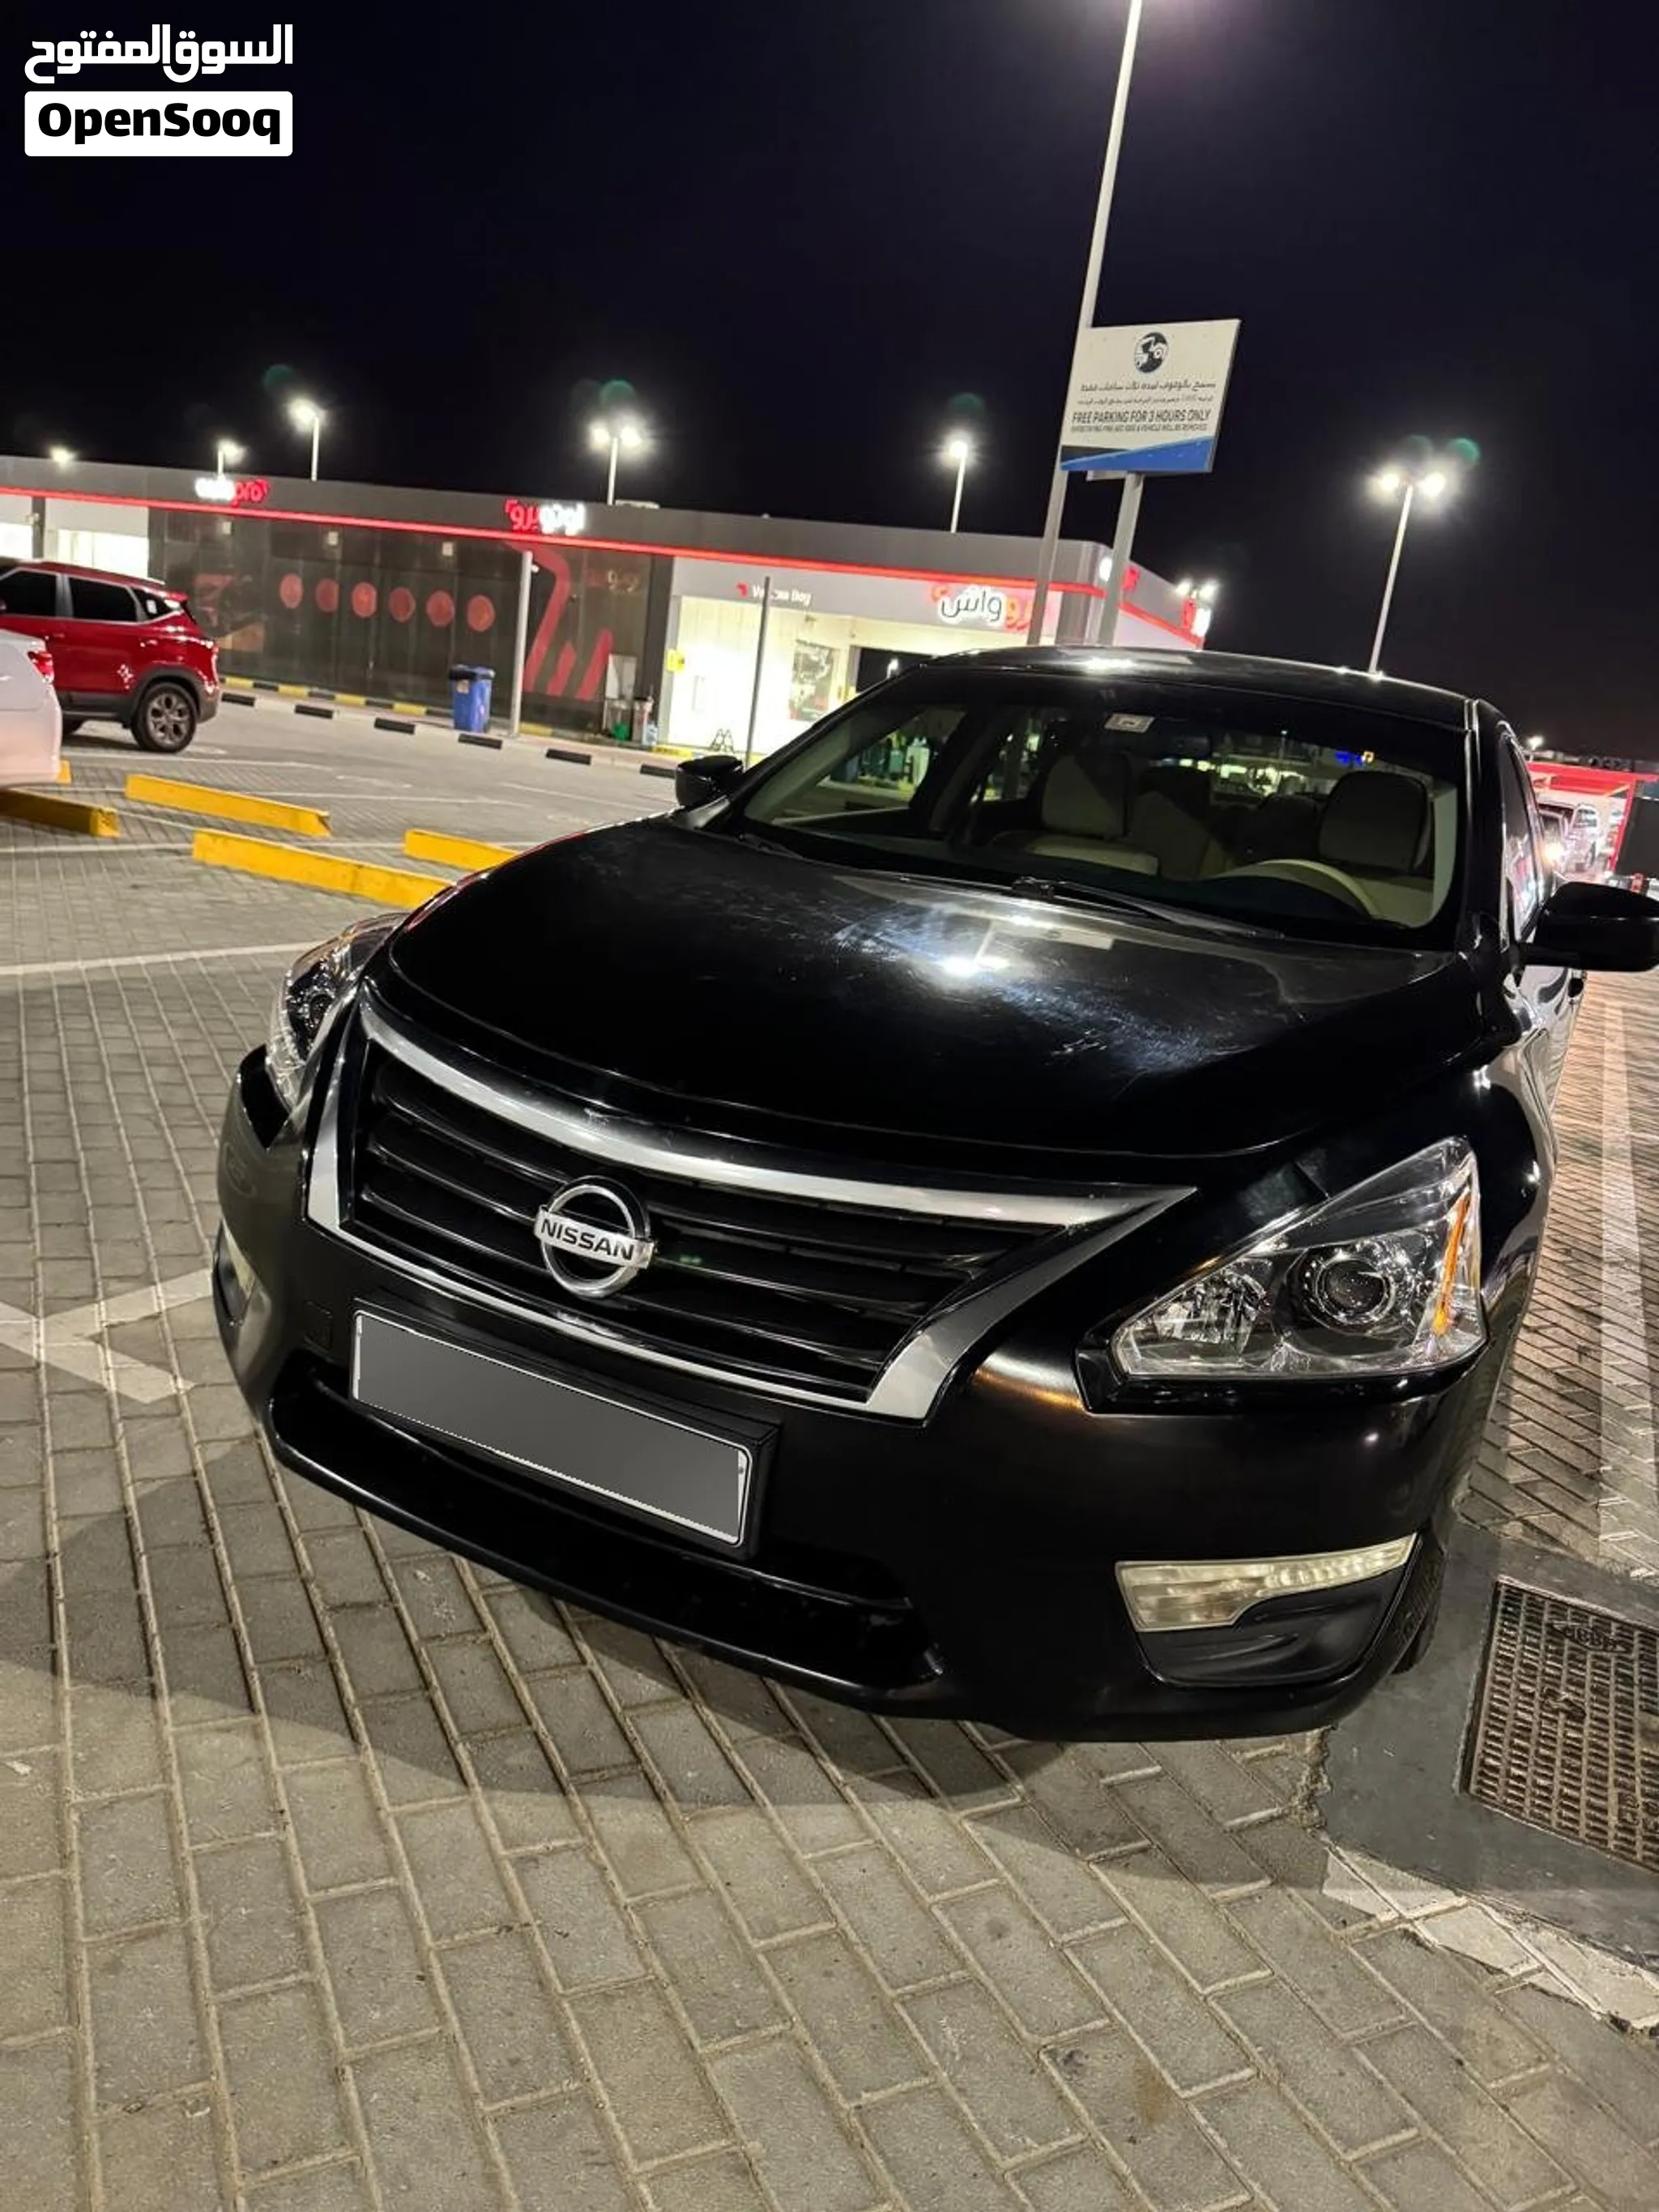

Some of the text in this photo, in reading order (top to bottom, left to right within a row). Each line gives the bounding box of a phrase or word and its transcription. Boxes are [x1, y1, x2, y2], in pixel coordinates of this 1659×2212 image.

[1072, 411, 1092, 424] FREE
[1092, 410, 1129, 423] PARKING
[1129, 409, 1147, 422] FOR
[1155, 409, 1186, 422] HOURS
[1187, 409, 1211, 421] ONLY
[541, 1218, 634, 1260] NISSAN
